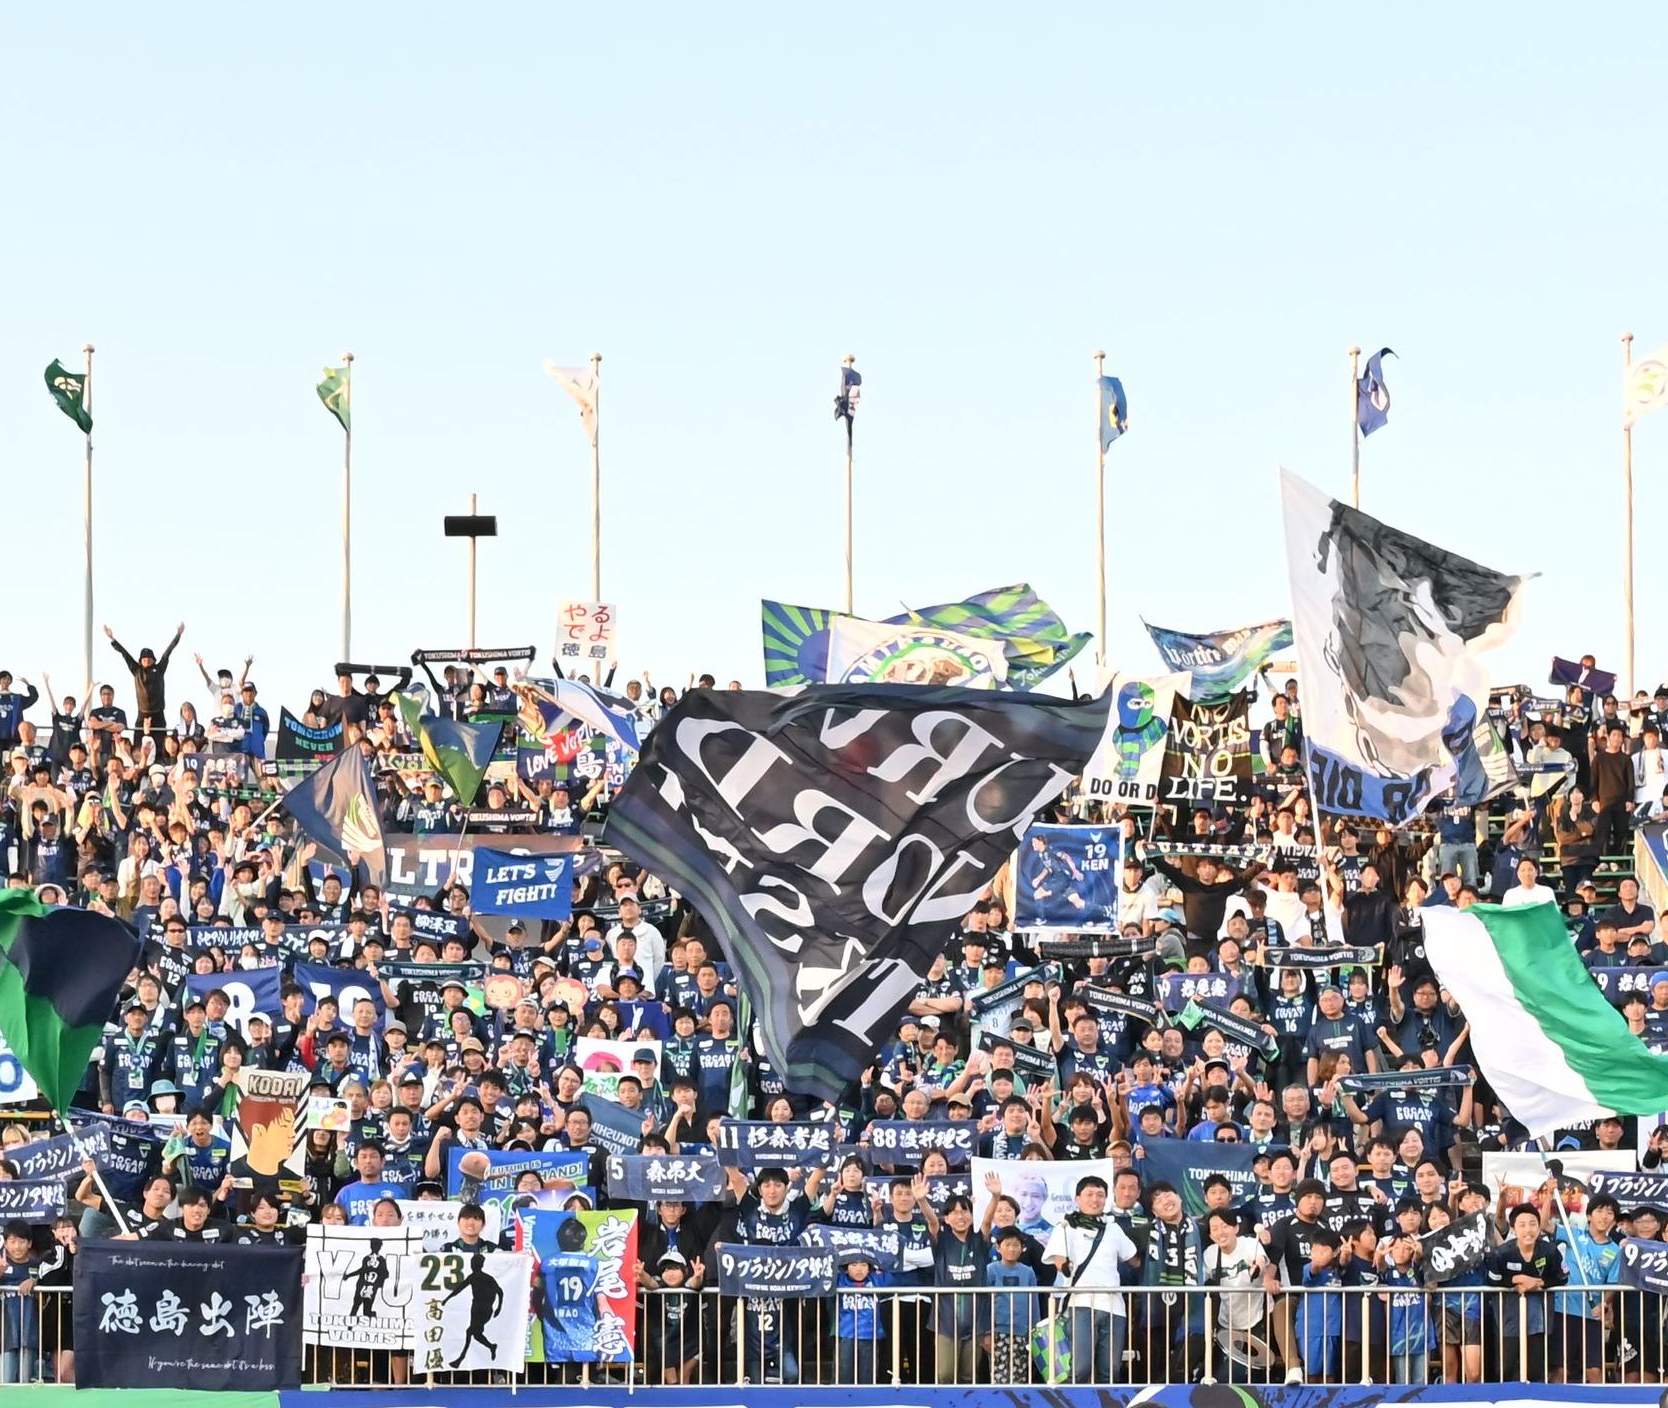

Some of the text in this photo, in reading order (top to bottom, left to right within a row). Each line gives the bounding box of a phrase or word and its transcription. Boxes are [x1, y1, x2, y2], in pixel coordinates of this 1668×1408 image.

[283, 714, 344, 737] TOMORROW
[294, 738, 334, 752] NEVER
[526, 741, 558, 777] LOVE
[574, 749, 605, 778] 島
[1182, 750, 1232, 779] NO
[1090, 778, 1140, 798] DO OR
[1166, 776, 1247, 802] LIFE.
[1085, 843, 1107, 859] 19
[486, 864, 536, 884] LET'S
[1081, 857, 1108, 871] KEN
[496, 884, 557, 906] FIGHT!
[1285, 1019, 1297, 1032] 16
[249, 1074, 302, 1097] KODAI
[719, 1126, 739, 1149] 11
[873, 1127, 896, 1149] 88
[490, 1161, 542, 1176] FUTURE IS
[612, 1158, 705, 1184] 5 森昂大
[490, 1175, 507, 1191] IN
[1590, 1174, 1605, 1193] 9
[801, 1229, 825, 1247] 13
[721, 1252, 734, 1276] 9
[1624, 1244, 1639, 1266] 9
[421, 1254, 465, 1291] 23
[559, 1276, 584, 1301] 19
[587, 1214, 632, 1362] 岩尾憲
[99, 1288, 284, 1339] 徳島出陣
[308, 1312, 415, 1330] TOKUSHIMA
[757, 1313, 774, 1332] 12
[328, 1327, 397, 1346] VORTIS
[423, 1298, 445, 1370] 高田優
